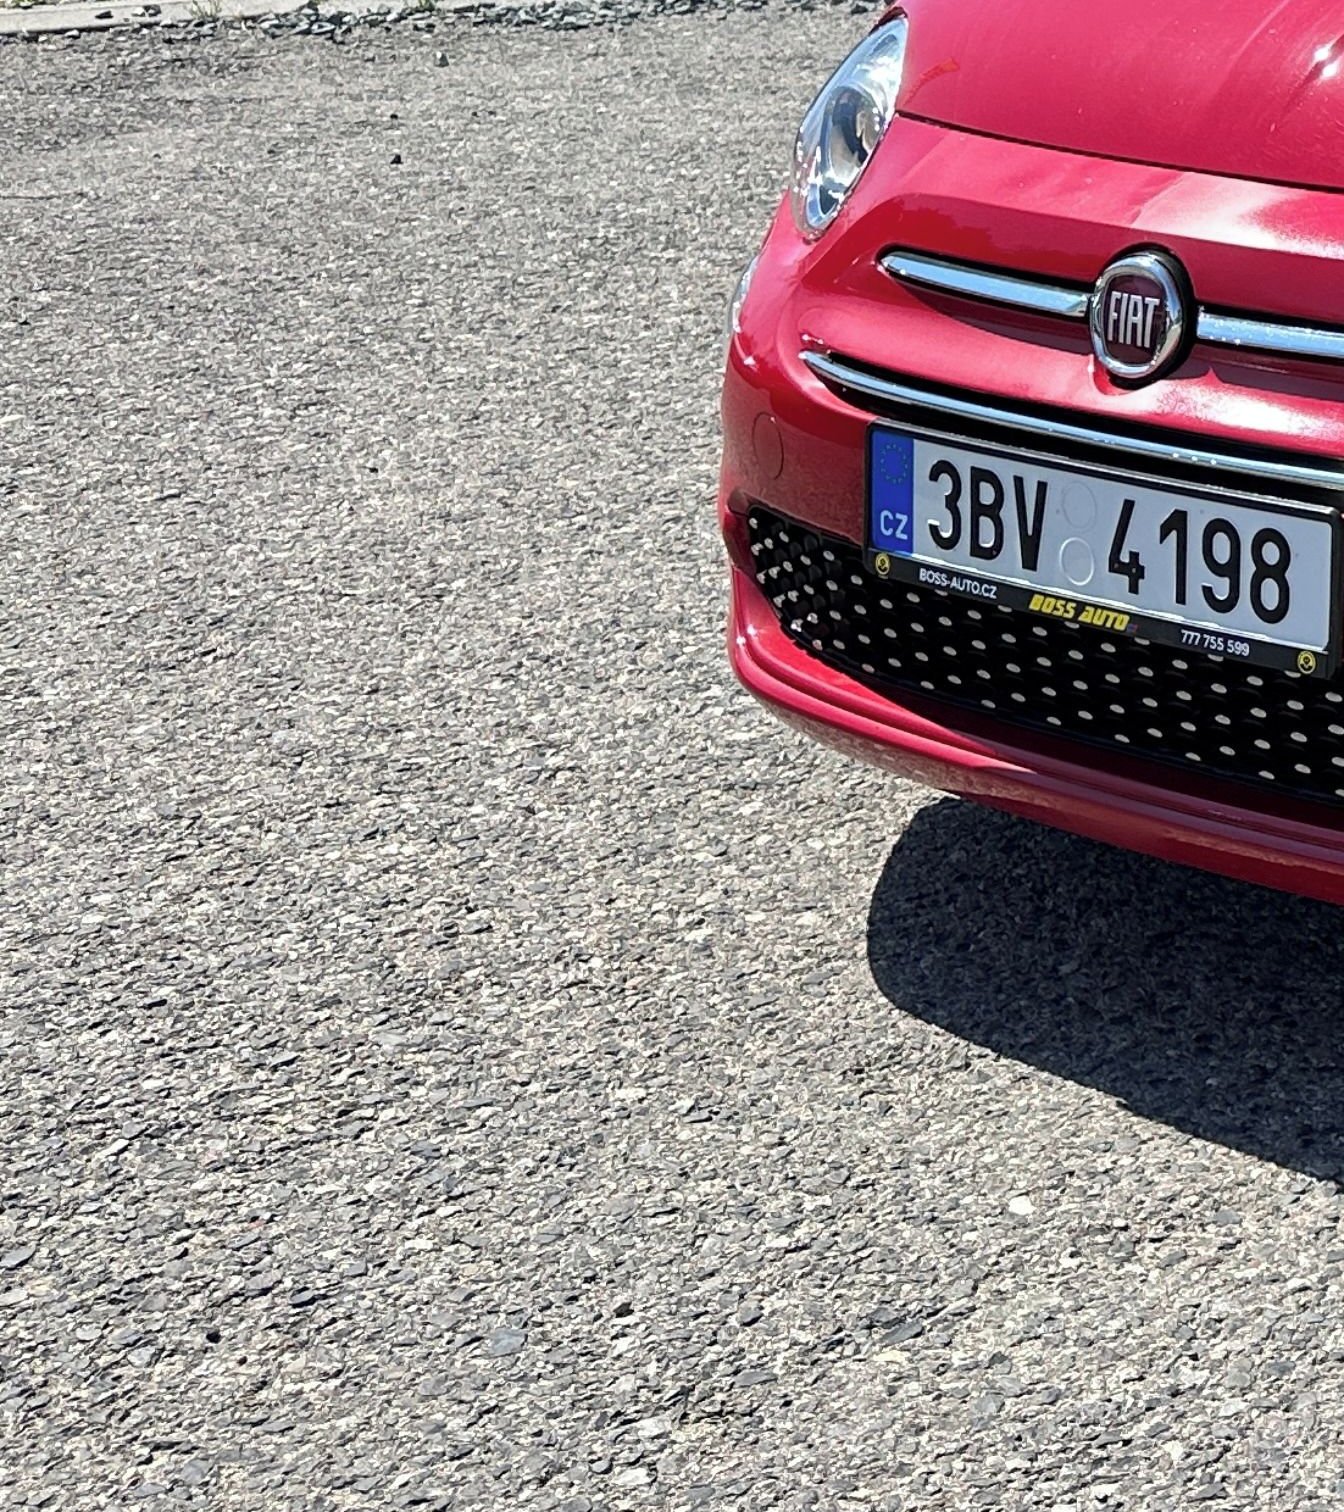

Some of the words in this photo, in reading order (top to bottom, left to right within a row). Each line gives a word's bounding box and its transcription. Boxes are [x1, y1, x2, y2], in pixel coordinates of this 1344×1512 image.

[1107, 291, 1160, 348] FIAT
[879, 509, 908, 544] CZ
[926, 459, 1048, 573] 3BV
[1107, 498, 1292, 626] 4198
[919, 568, 998, 600] BOSS-AUTO.CZ
[1028, 594, 1077, 619] BOSS
[1077, 608, 1131, 632] AUTO
[1180, 629, 1202, 646] 777
[1202, 634, 1225, 651] 755
[1226, 639, 1250, 657] 599
